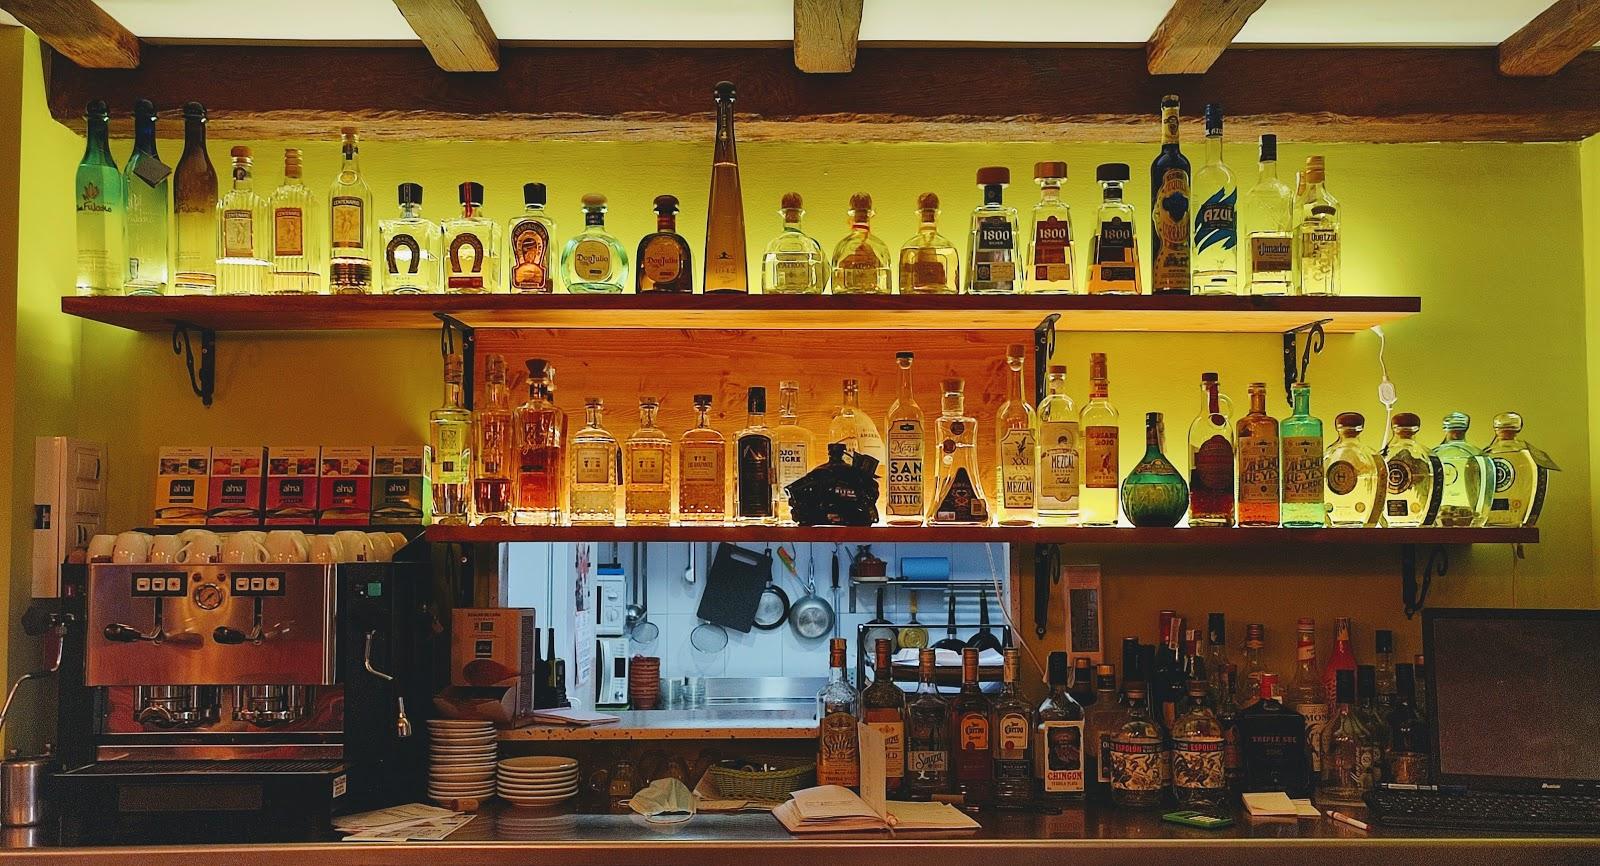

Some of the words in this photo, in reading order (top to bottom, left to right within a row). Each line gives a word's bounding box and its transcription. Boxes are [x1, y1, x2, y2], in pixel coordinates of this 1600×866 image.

[1204, 208, 1233, 222] AZUL
[983, 230, 1010, 240] 1800
[1039, 228, 1066, 239] 1800
[1104, 229, 1130, 239] 1800
[1051, 454, 1074, 469] MEZCAL
[890, 461, 922, 474] SAN
[890, 474, 922, 483] COSME
[173, 483, 191, 493] alma
[225, 483, 243, 493] alma
[283, 484, 300, 492] alma
[336, 484, 353, 493] alma
[388, 484, 406, 492] alma
[1007, 481, 1033, 493] MEZCAL
